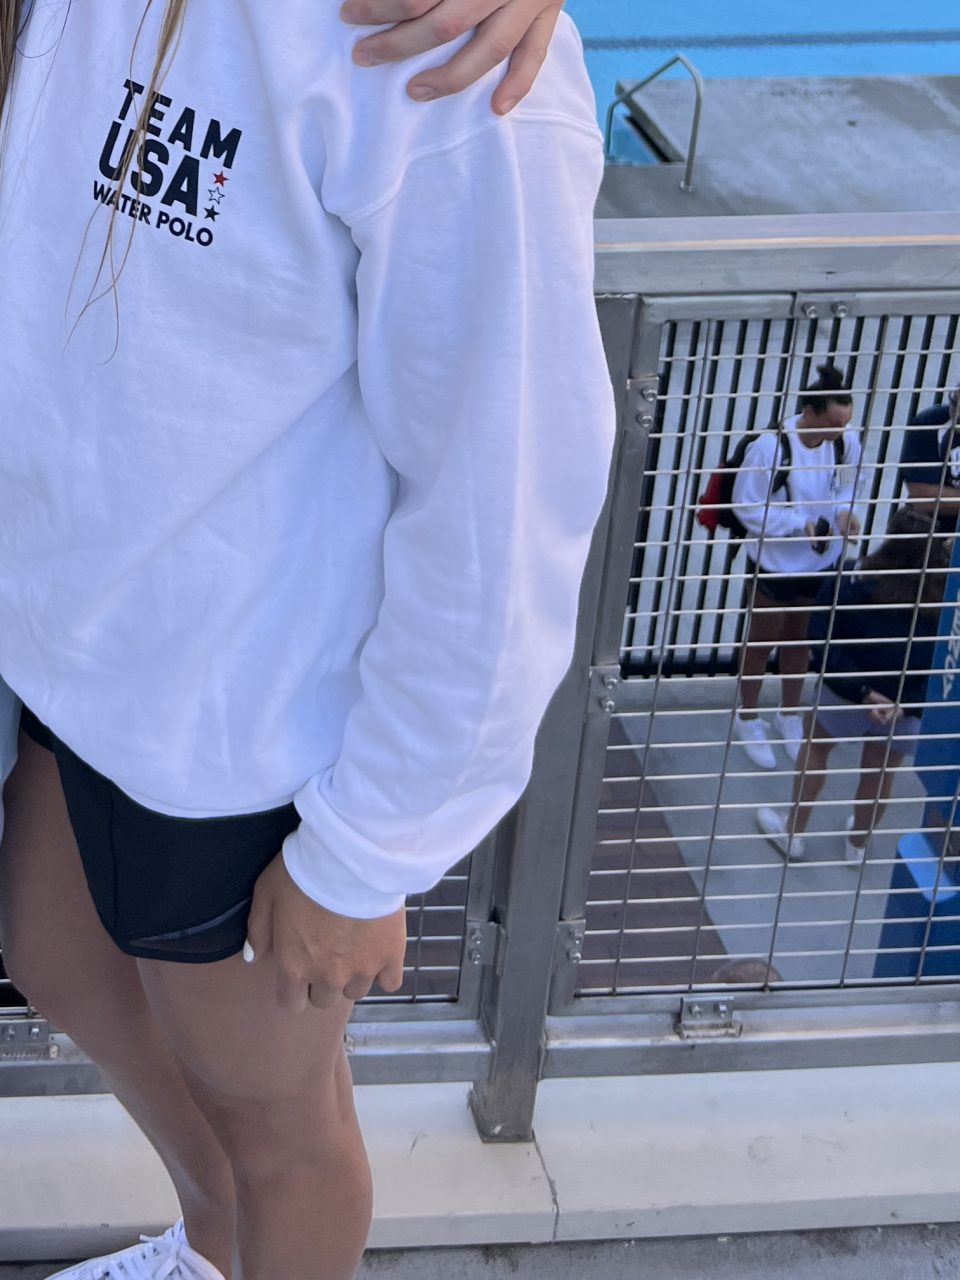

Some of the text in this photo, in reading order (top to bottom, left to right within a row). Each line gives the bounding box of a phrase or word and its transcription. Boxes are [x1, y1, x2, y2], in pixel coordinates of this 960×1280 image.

[98, 120, 200, 218] USA
[118, 79, 243, 170] TEAM
[93, 180, 214, 247] WATER POLO
